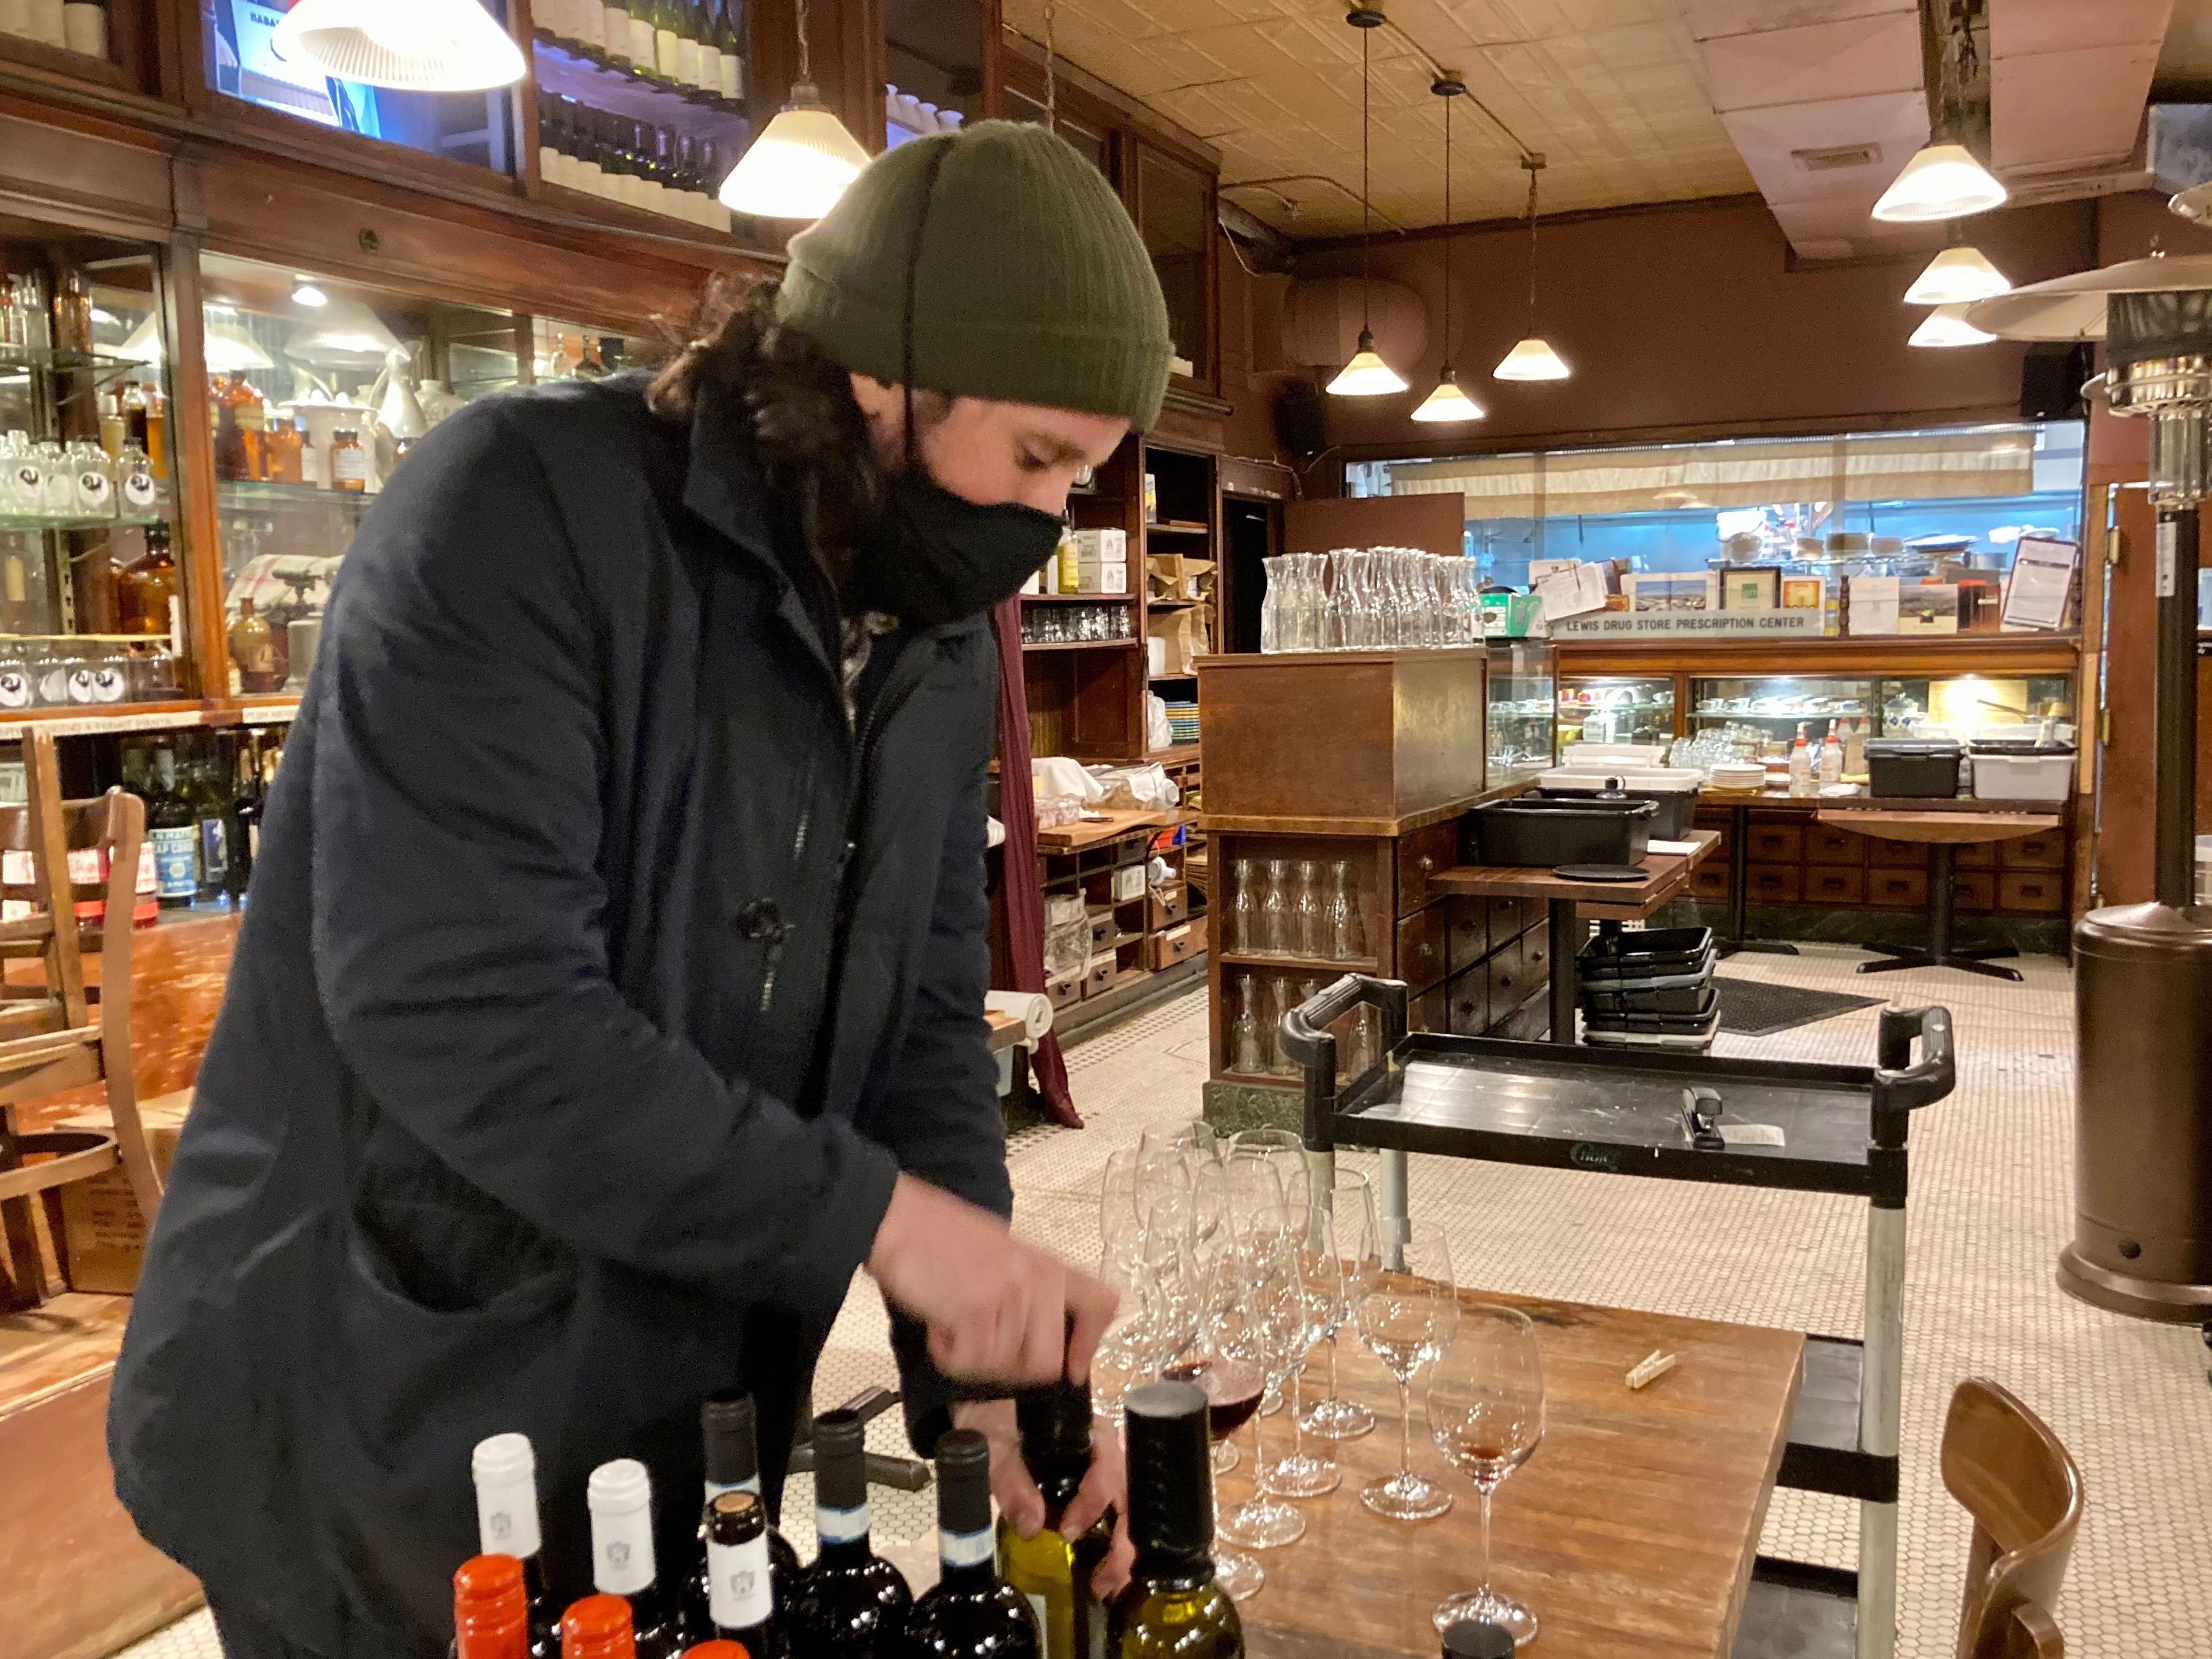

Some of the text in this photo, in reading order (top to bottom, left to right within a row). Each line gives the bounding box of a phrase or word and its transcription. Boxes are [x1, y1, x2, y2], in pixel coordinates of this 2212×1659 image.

[1567, 617, 1804, 631] LEWIS DRUG STORE PRESCRIPTION CENTER
